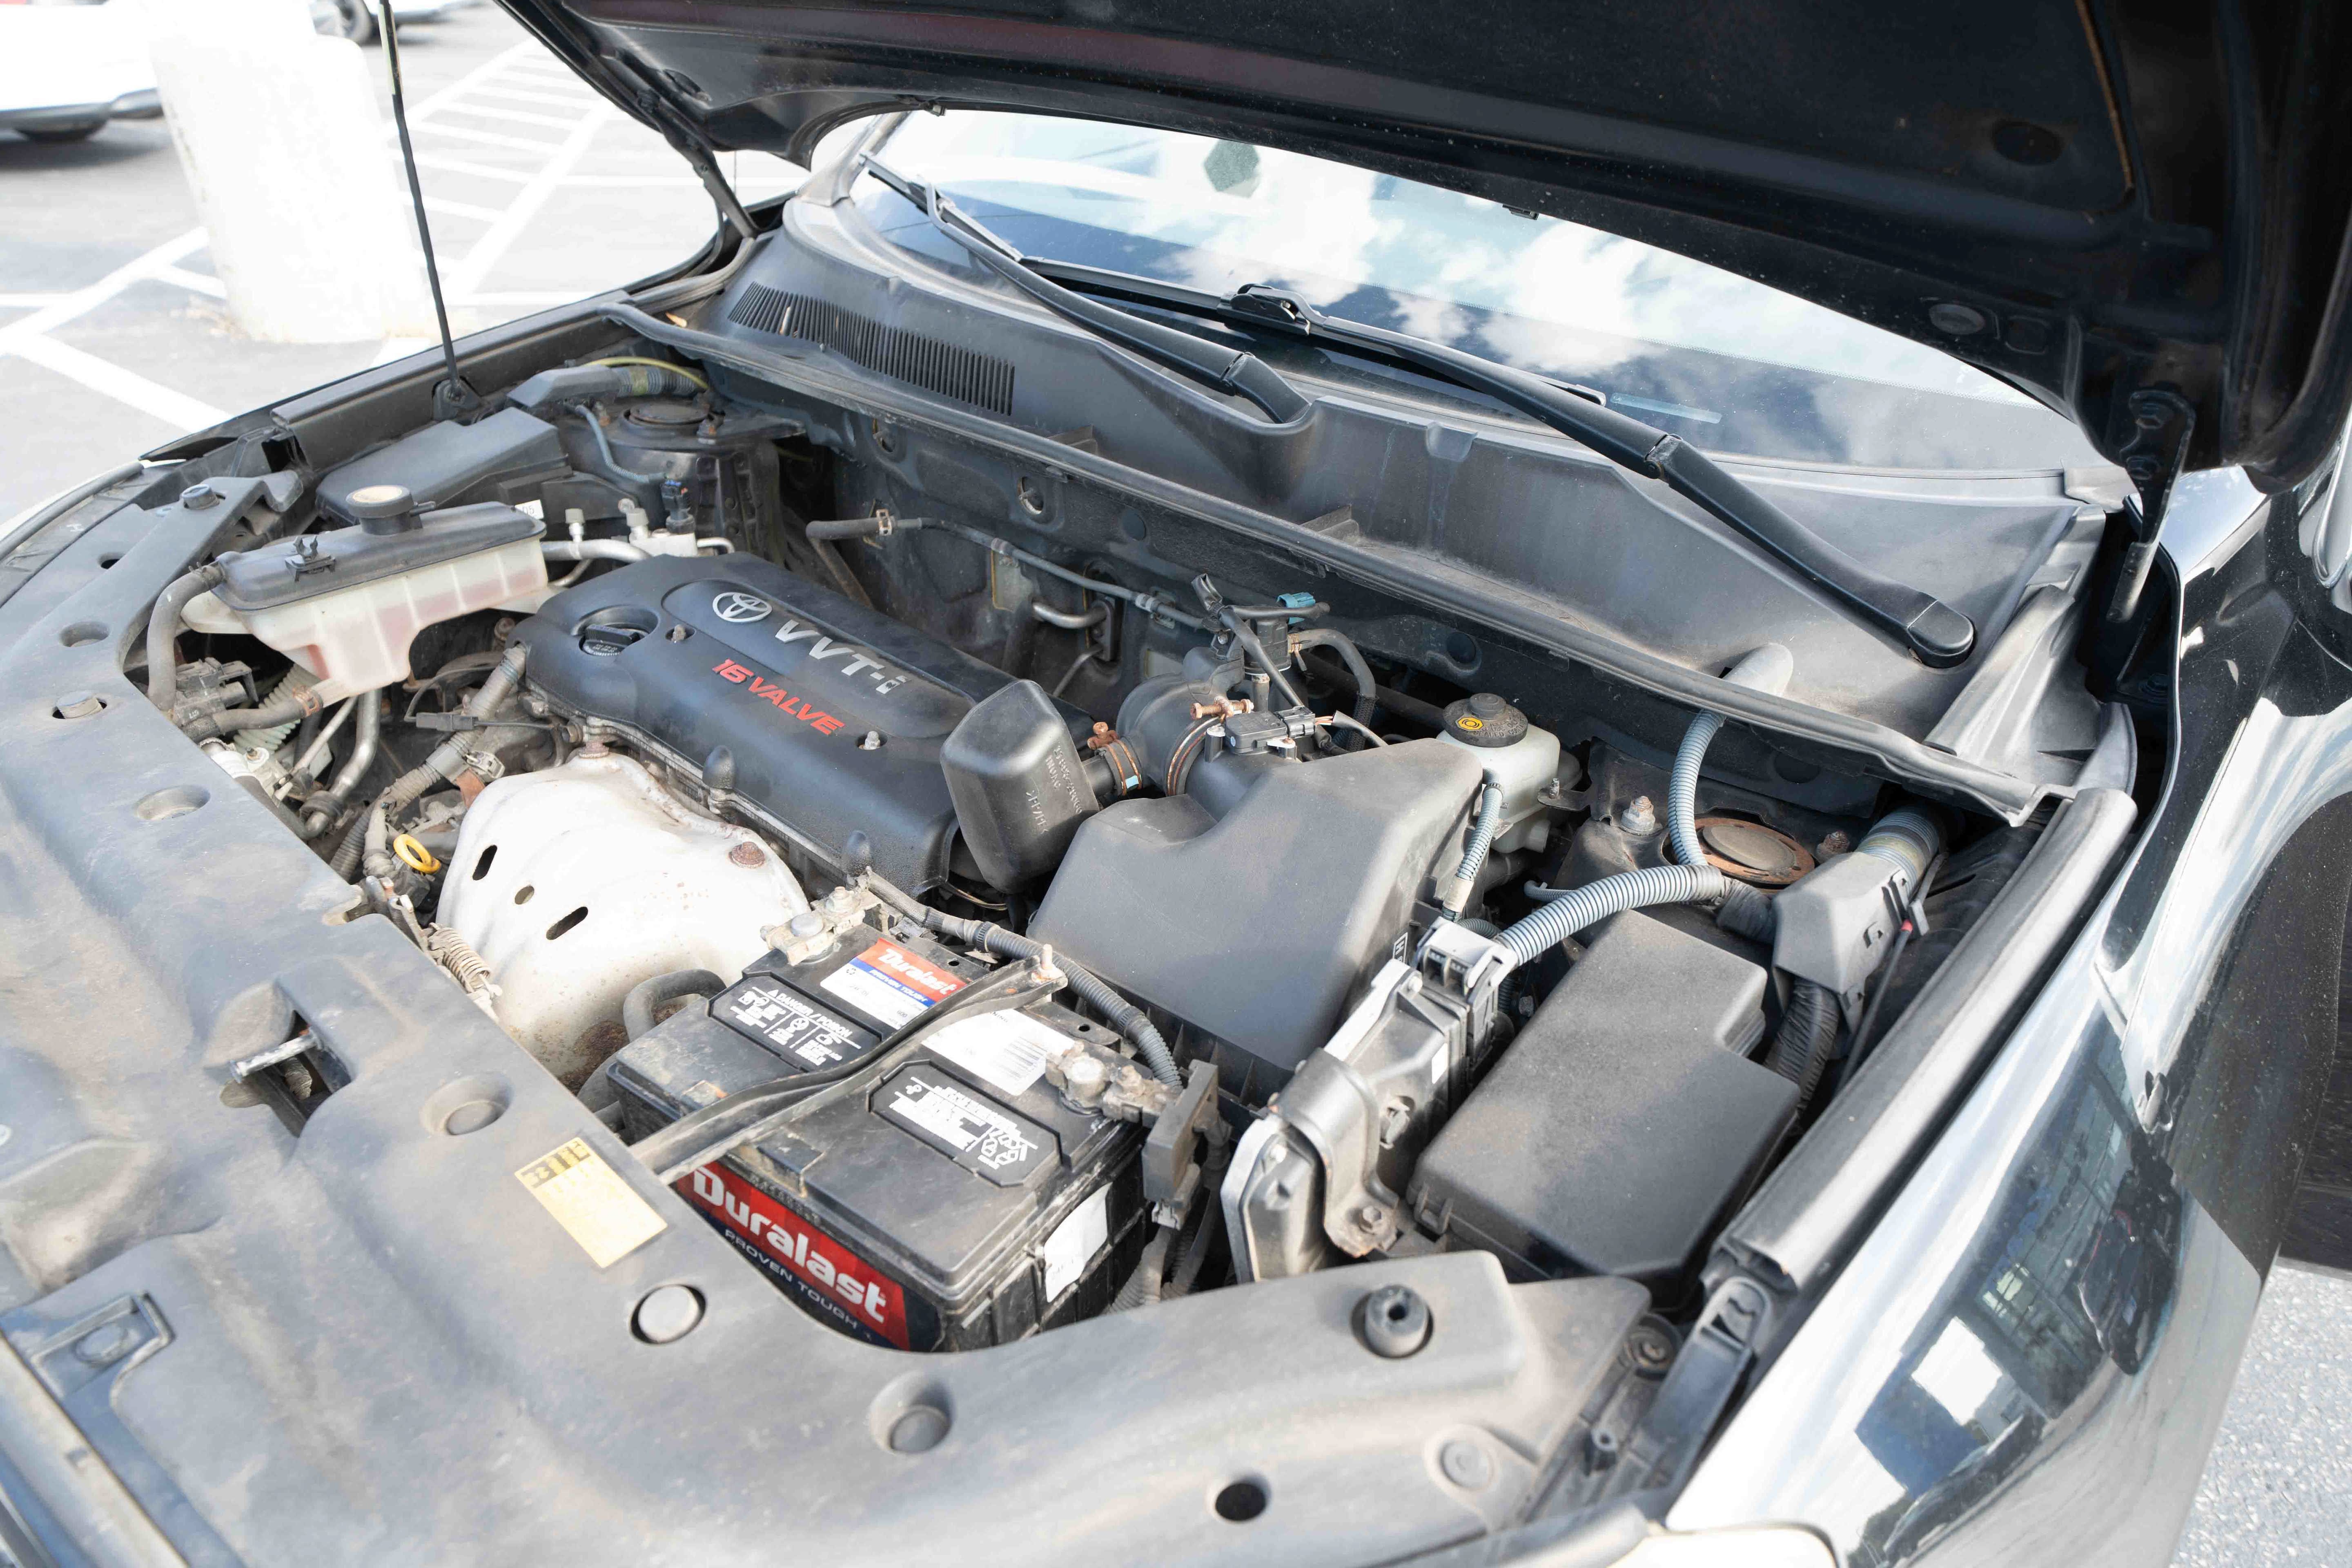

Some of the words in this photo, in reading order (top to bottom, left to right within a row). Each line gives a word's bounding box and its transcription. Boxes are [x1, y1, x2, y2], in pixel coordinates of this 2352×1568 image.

[775, 620, 911, 694] VVT-i
[712, 658, 754, 684] 16
[748, 676, 845, 735] VALVE
[878, 949, 957, 995] Duralast
[775, 993, 814, 1016] DANGER
[816, 1016, 853, 1038] POISON
[693, 1167, 886, 1324] Duralast
[725, 1229, 793, 1283] PROVEN
[798, 1281, 857, 1330] TOUGH
